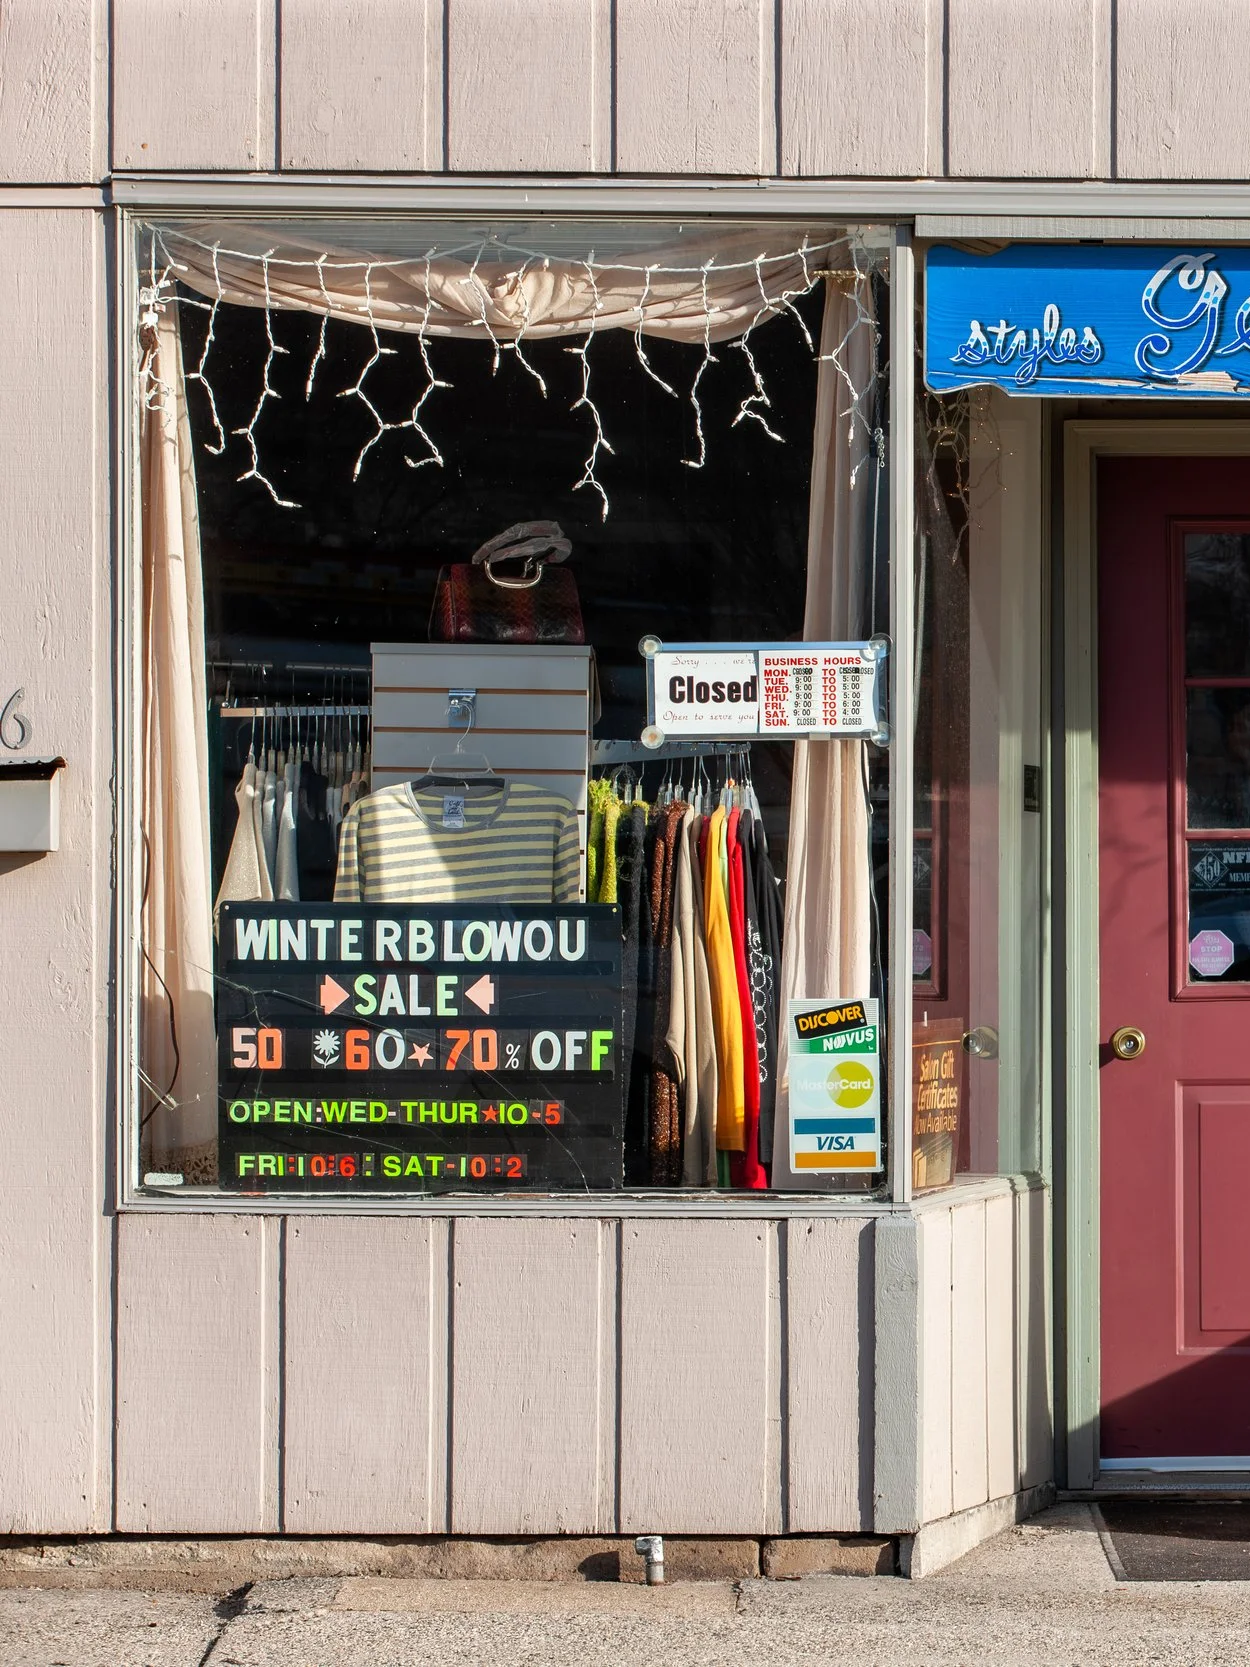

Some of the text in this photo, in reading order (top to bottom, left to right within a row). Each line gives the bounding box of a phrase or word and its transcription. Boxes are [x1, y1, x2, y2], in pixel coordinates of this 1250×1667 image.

[956, 303, 1102, 383] styles
[671, 655, 700, 668] Sorry
[764, 657, 862, 666] BUSINESS HOURS
[764, 669, 792, 677] MON.
[669, 675, 758, 704] Closed
[764, 678, 788, 686] TUE.
[662, 710, 688, 722] Open
[694, 712, 704, 720] to
[737, 715, 755, 724] you
[354, 974, 458, 1016] SALE
[798, 1005, 864, 1032] DISCOVER
[232, 1027, 282, 1069] 50
[345, 1028, 406, 1070] 60
[531, 1030, 614, 1071] OFF
[822, 1028, 875, 1052] NOVUS
[920, 1050, 954, 1082] Salon Gift
[796, 1078, 872, 1092] MasterCard
[917, 1081, 958, 1112] Certificates
[927, 1112, 957, 1134] Available
[816, 1136, 855, 1151] VISA
